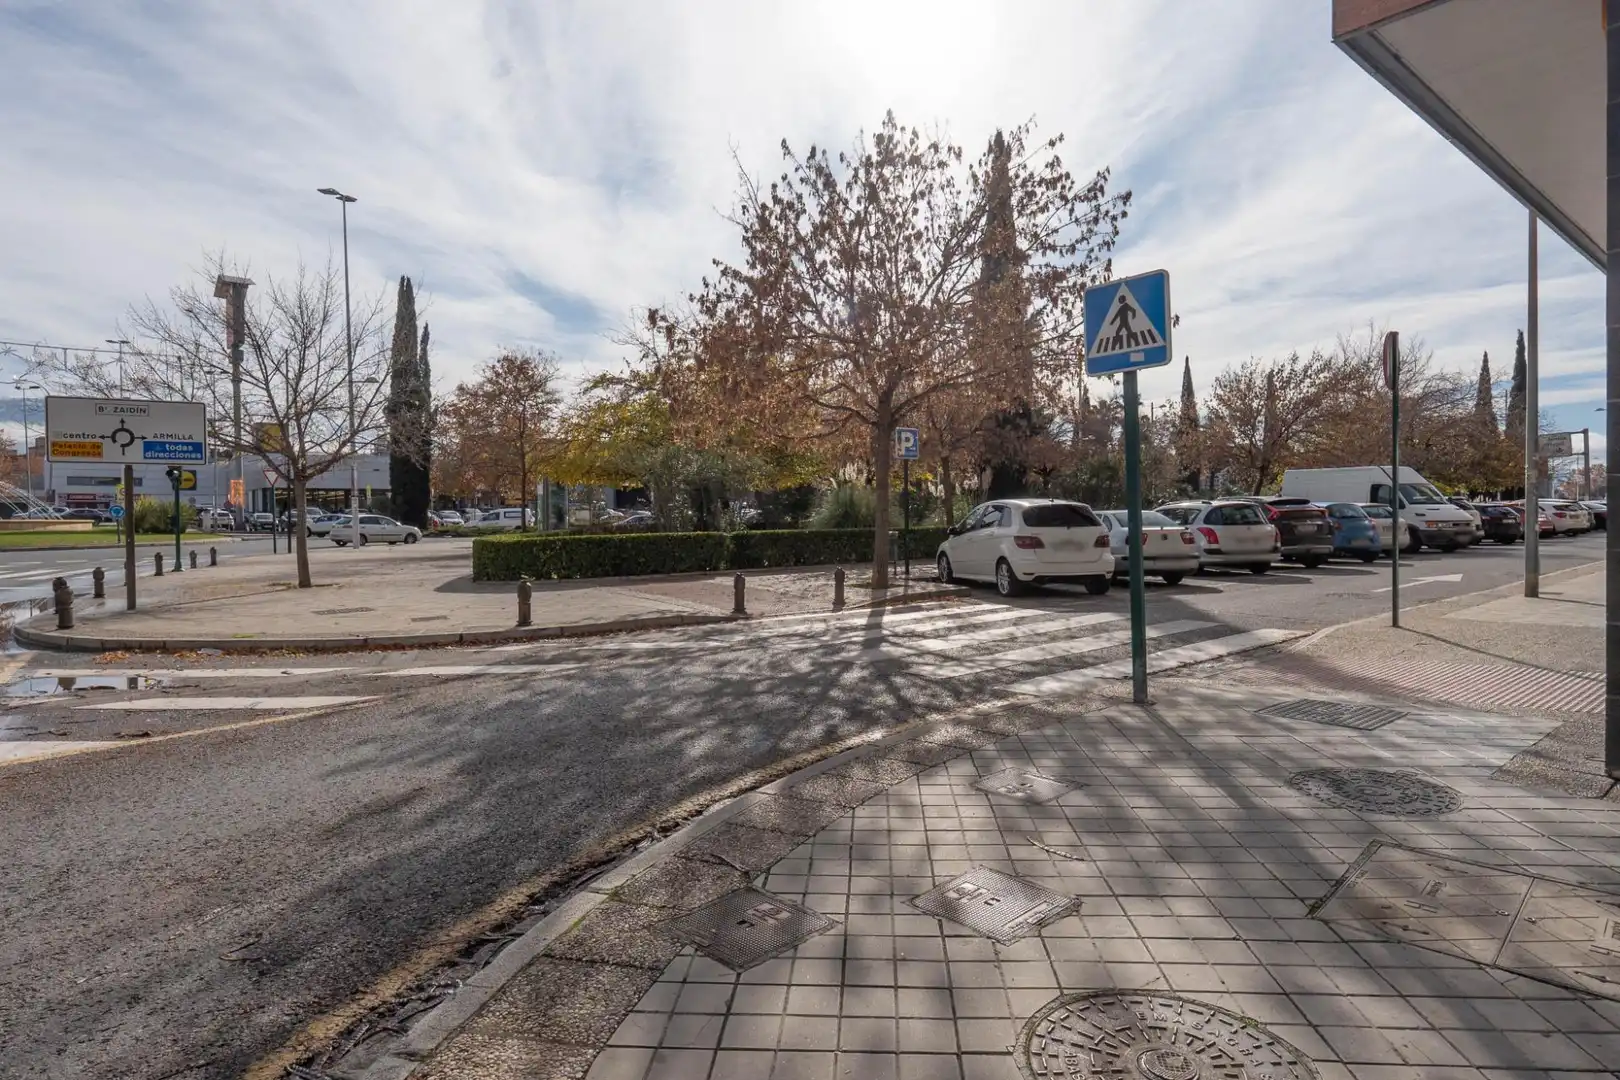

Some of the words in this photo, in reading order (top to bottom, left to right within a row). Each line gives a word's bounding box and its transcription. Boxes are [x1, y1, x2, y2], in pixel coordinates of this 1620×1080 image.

[113, 405, 147, 414] ZAIDÍN
[63, 432, 97, 440] centro
[152, 432, 194, 441] ARMILLA
[165, 443, 194, 451] todas
[900, 431, 915, 456] P
[145, 450, 202, 459] direcciones
